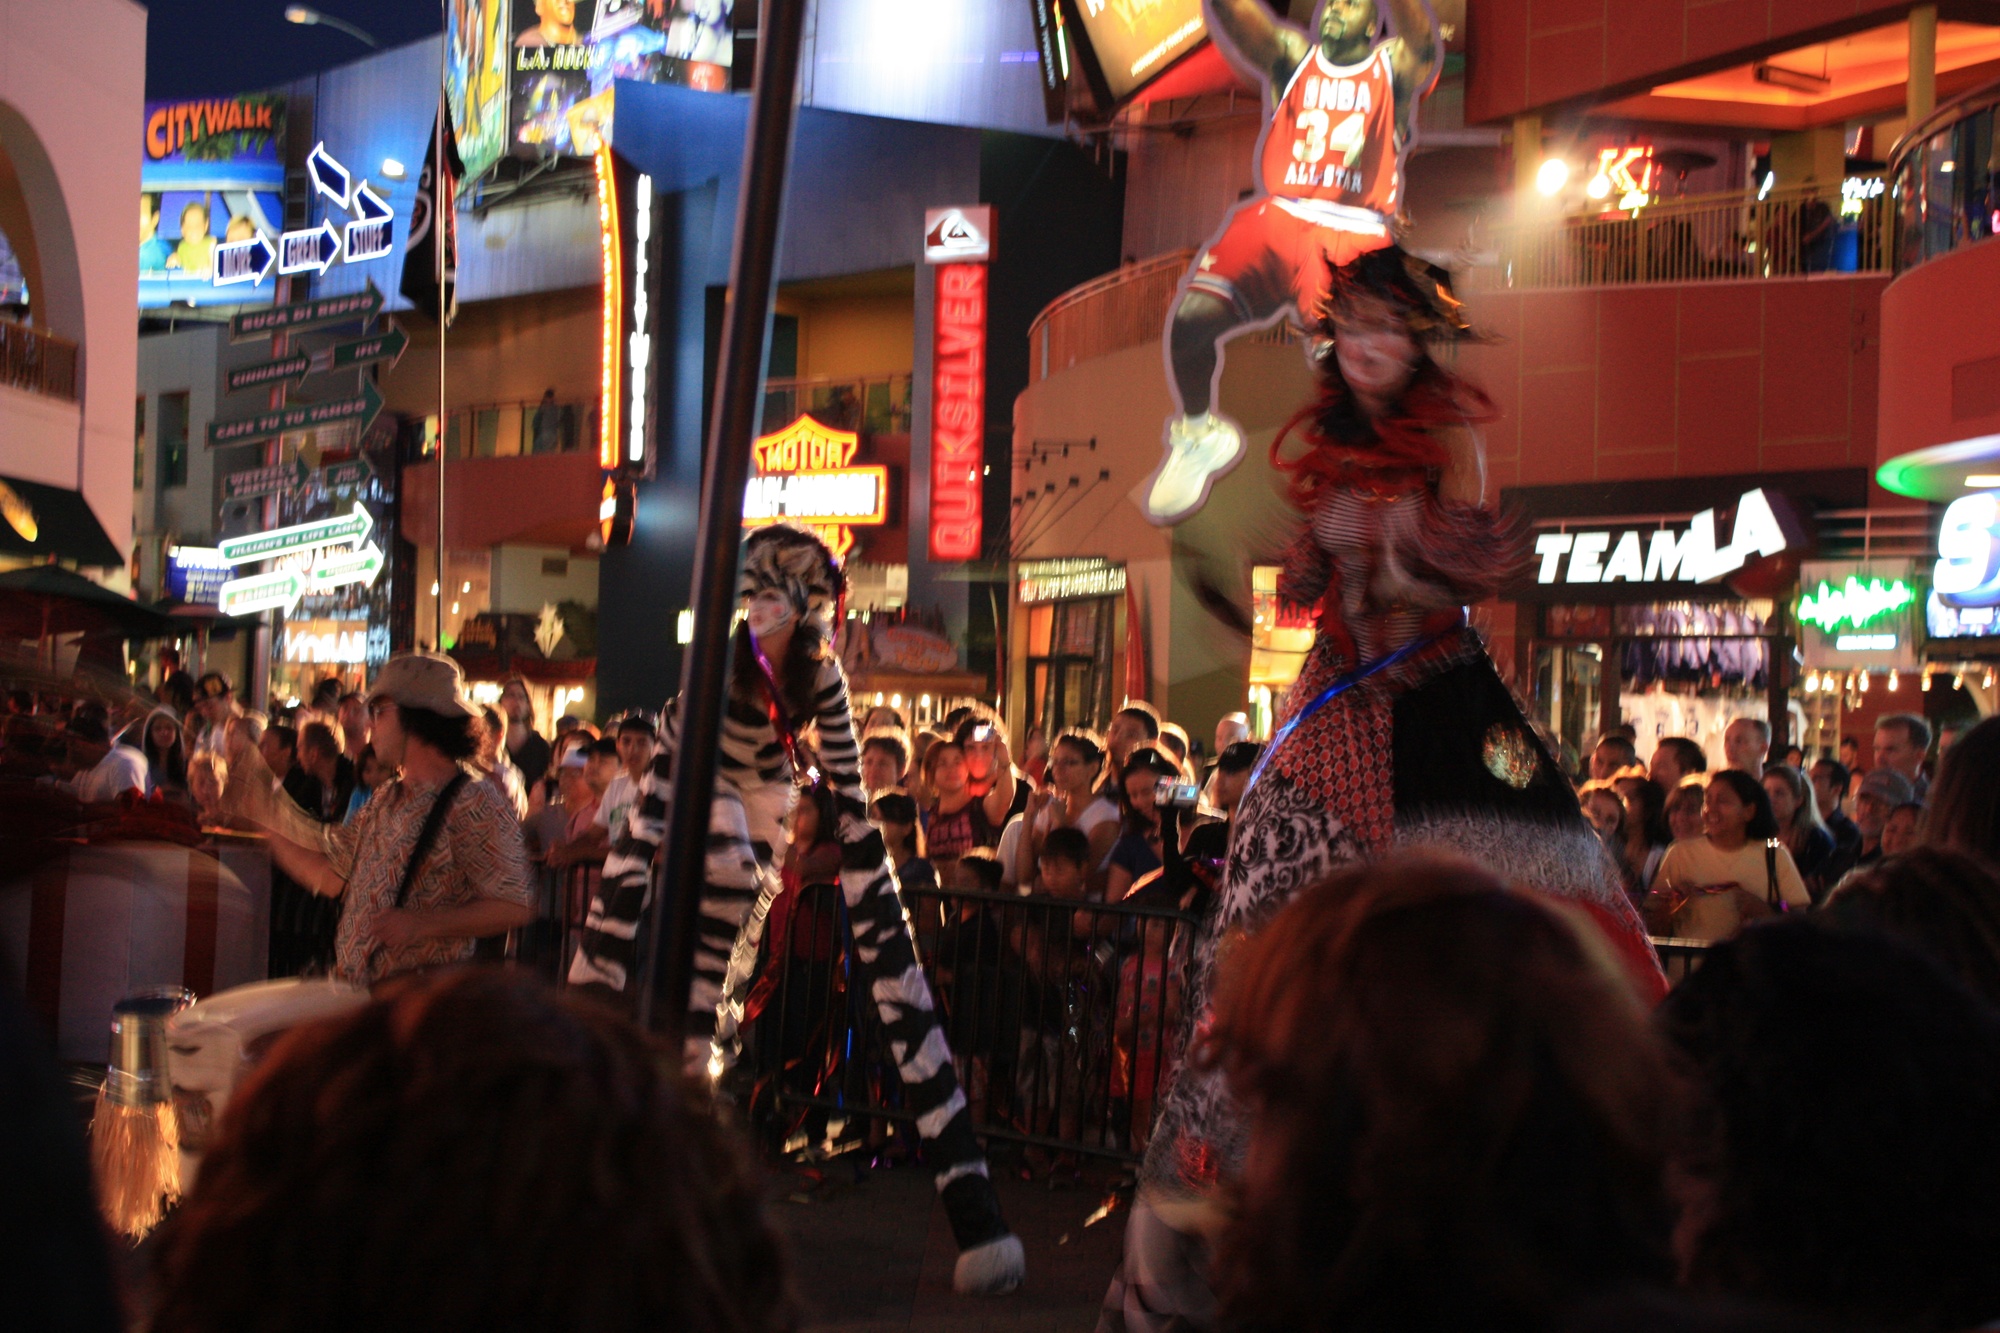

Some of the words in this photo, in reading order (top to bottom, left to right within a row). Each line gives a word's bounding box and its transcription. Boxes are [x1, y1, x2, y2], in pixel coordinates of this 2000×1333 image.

[146, 100, 272, 158] CITYWALK
[1292, 108, 1365, 169] 34
[287, 234, 322, 267] GREAT
[352, 223, 384, 256] STUFF
[222, 245, 252, 279] MORE
[241, 311, 288, 331] BUCA
[292, 306, 313, 322] DI
[316, 294, 374, 318] BEPPO
[232, 357, 307, 386] CINNABON
[216, 420, 255, 439] CAFE
[258, 416, 280, 431] TU
[284, 411, 305, 426] TU
[310, 400, 366, 421] TANGO
[933, 264, 984, 558] QUIKSILVER
[765, 427, 844, 471] MOTOR
